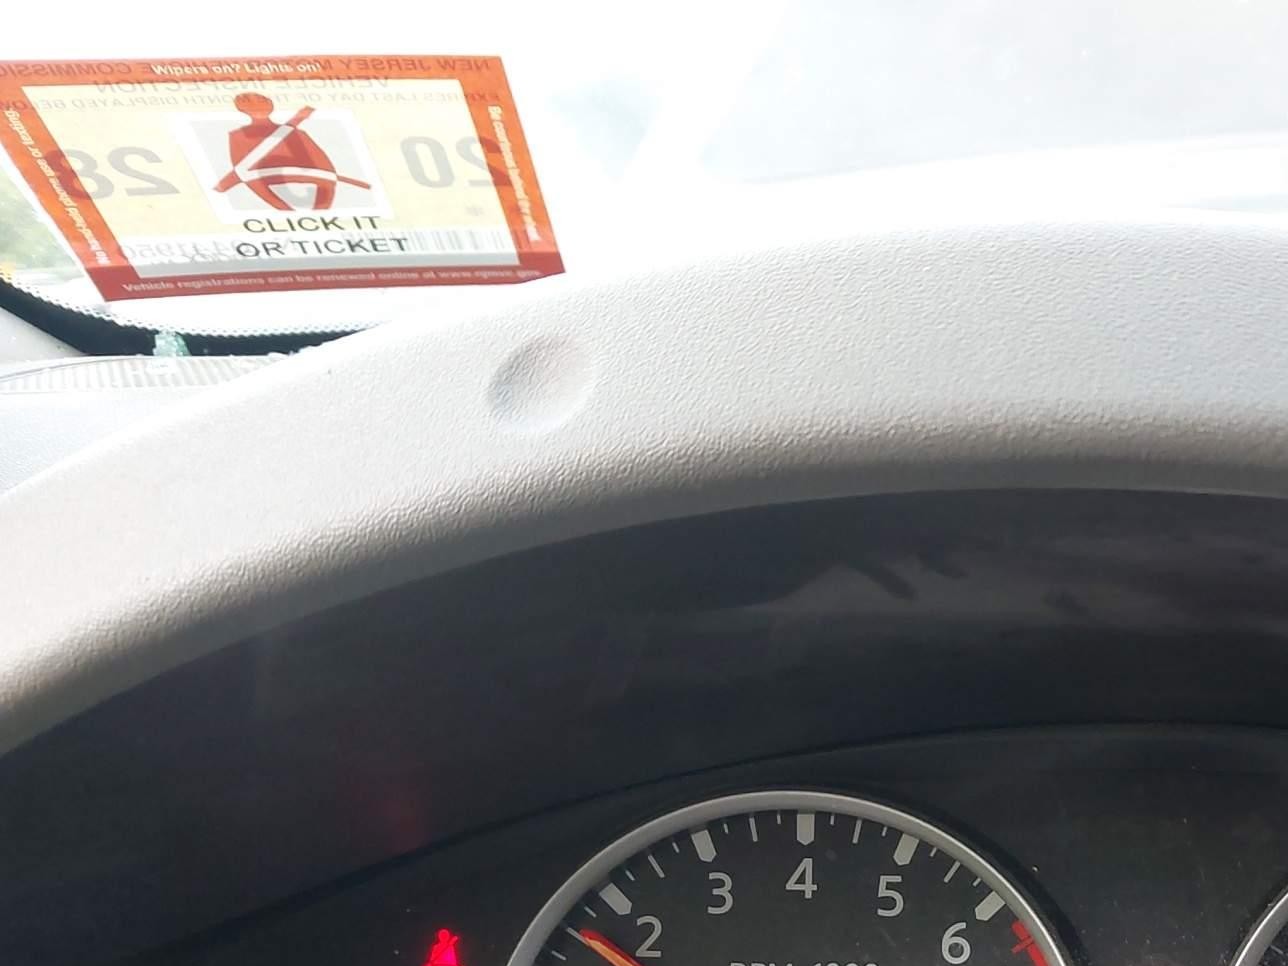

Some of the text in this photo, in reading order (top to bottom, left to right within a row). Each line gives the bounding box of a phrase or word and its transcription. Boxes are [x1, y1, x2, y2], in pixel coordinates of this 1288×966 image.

[151, 62, 321, 77] Wipers on? Lights on!
[28, 145, 43, 159] or
[37, 158, 56, 176] use
[48, 174, 77, 208] phone
[243, 215, 381, 233] CLICK IT
[235, 237, 408, 258] OR TICKET
[122, 280, 176, 293] Vehicle
[177, 274, 265, 290] registrations
[268, 274, 294, 284] can
[786, 858, 817, 898] 4
[708, 873, 732, 914] 3
[878, 876, 903, 916] 5
[636, 916, 661, 957] 2
[942, 923, 970, 964] 6
